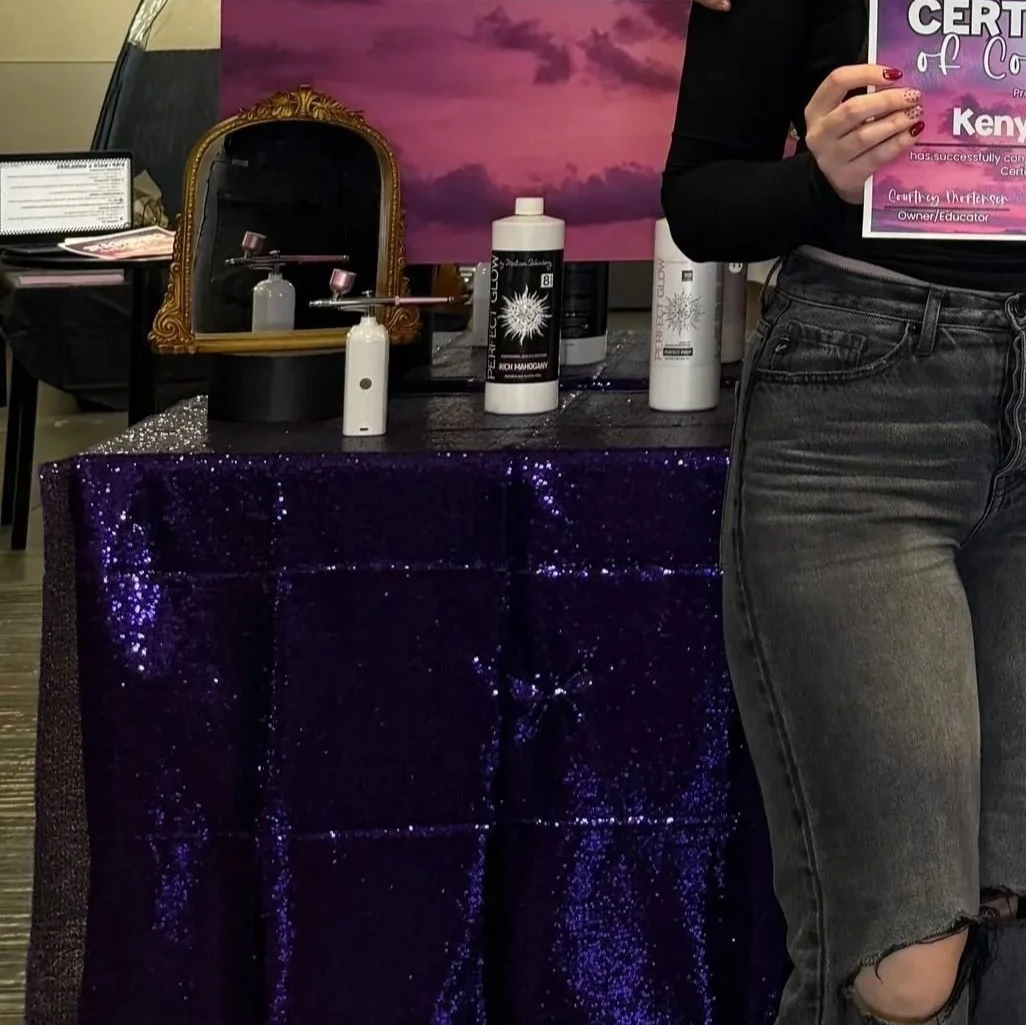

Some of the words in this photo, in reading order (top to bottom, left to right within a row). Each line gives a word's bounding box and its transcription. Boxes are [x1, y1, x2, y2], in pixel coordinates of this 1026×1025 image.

[917, 34, 961, 76] of
[910, 151, 931, 162] has
[934, 152, 1001, 165] successfully
[897, 211, 990, 223] Owner/Educator
[491, 254, 500, 304] GLOW
[657, 259, 666, 298] GLOW
[487, 310, 498, 380] PERFECT
[655, 300, 665, 362] PERFECT
[514, 361, 549, 371] MAHOGANY
